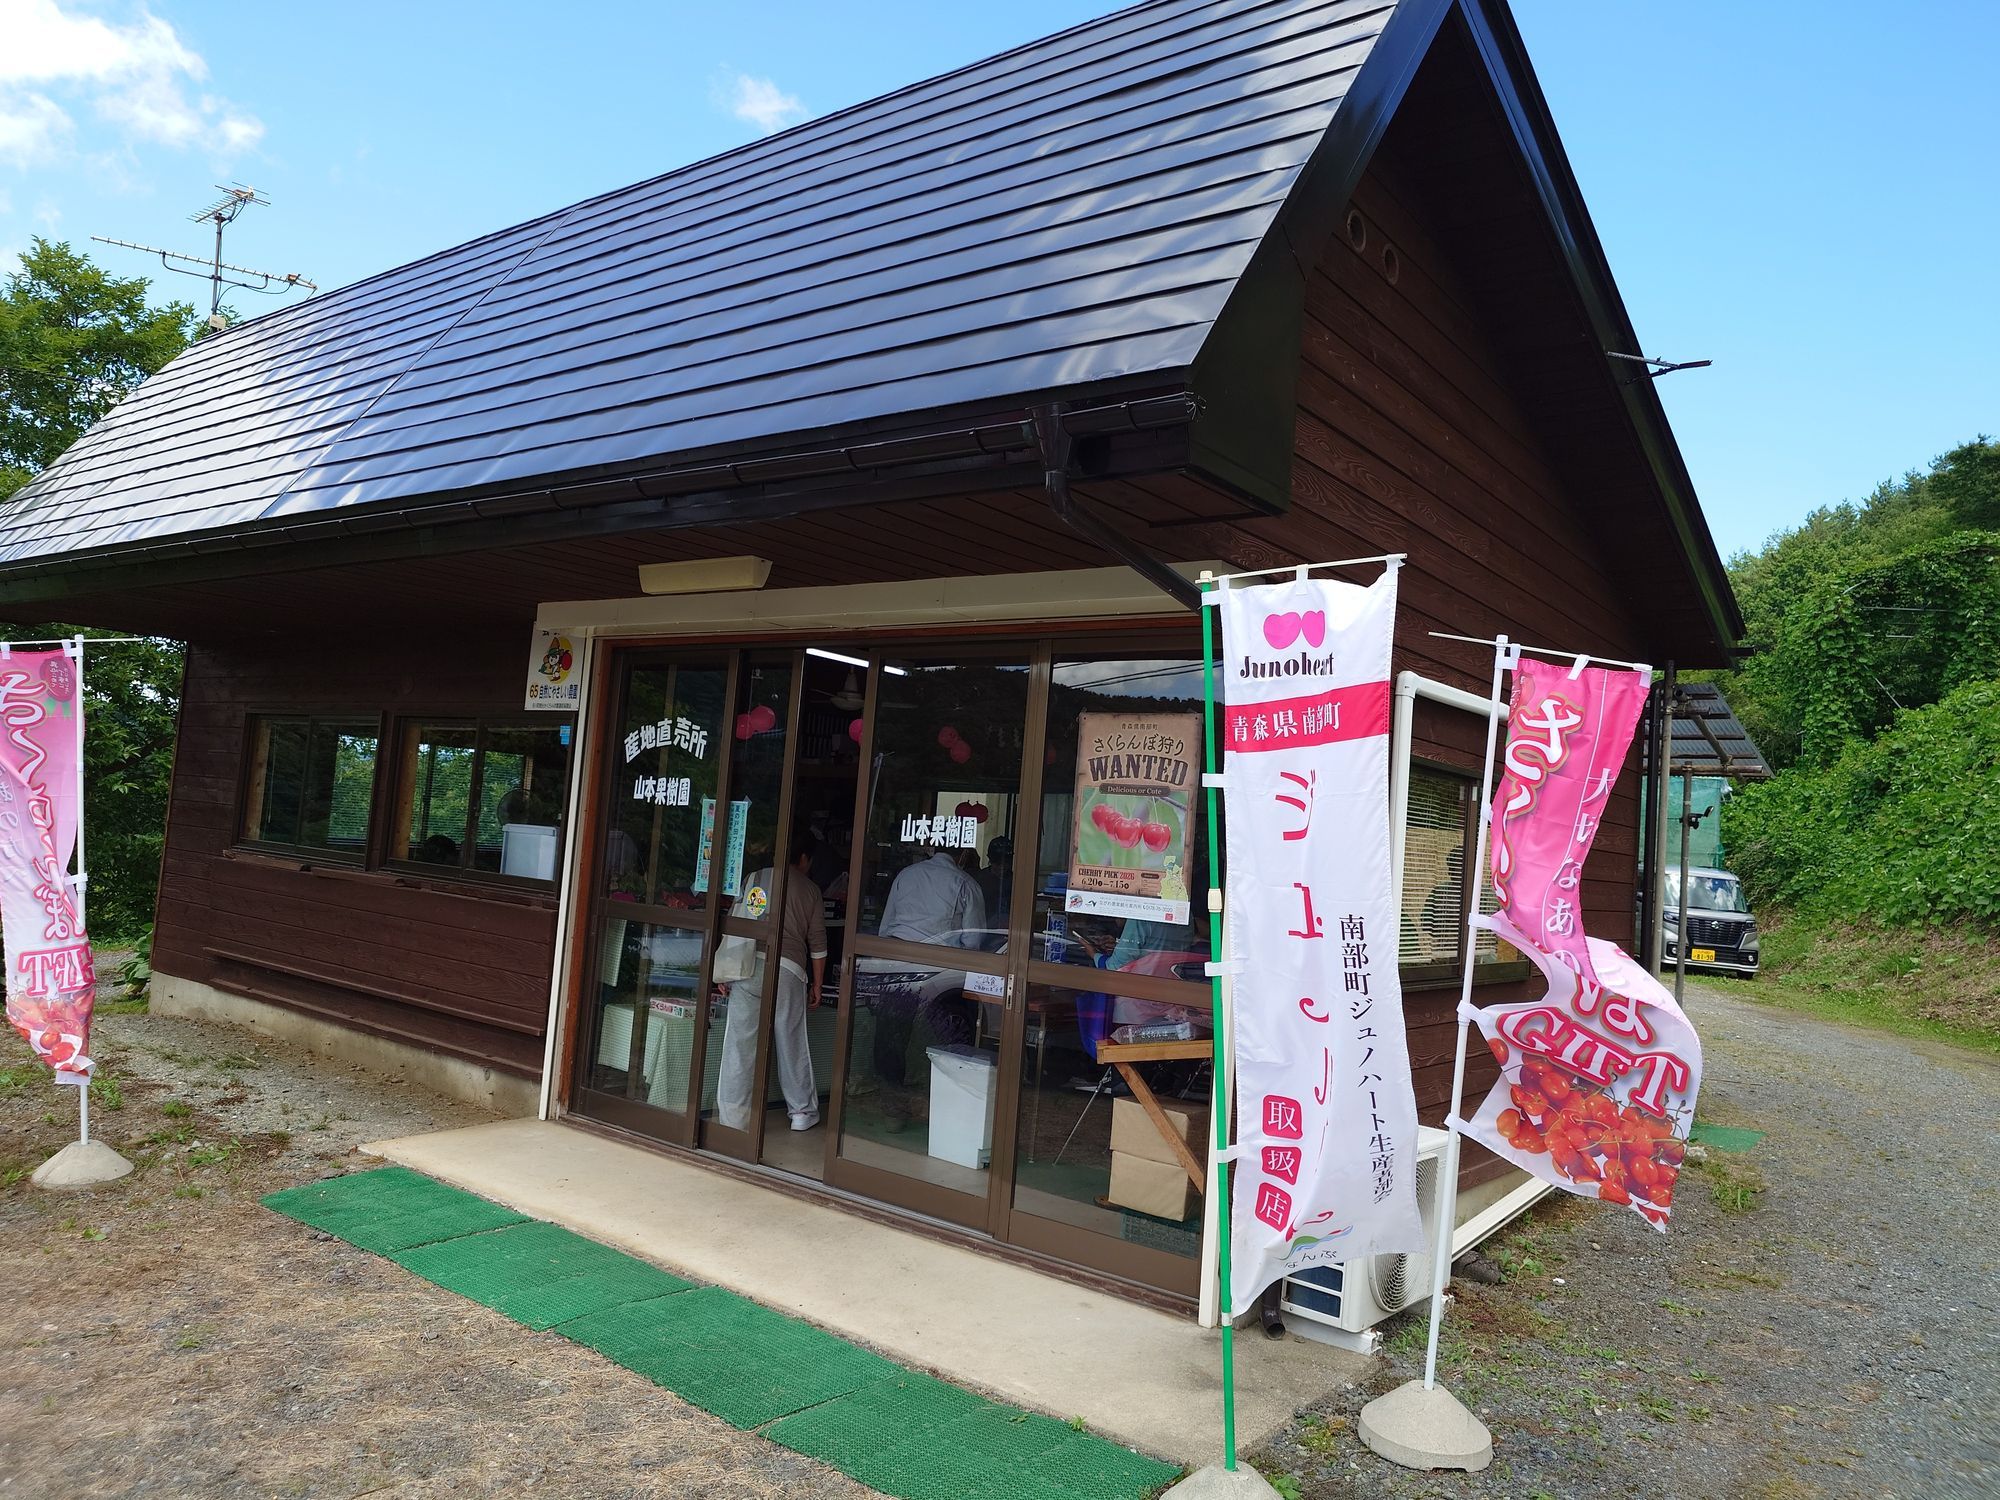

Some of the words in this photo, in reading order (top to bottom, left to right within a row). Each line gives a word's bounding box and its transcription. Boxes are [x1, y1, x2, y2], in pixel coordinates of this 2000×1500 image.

[529, 684, 539, 698] 65
[624, 716, 708, 764] 産地直売所
[1093, 733, 1185, 756] さくらんぼ狩り
[1087, 754, 1189, 787] WANTED
[633, 775, 691, 806] 山本果樹園
[1107, 785, 1137, 794] Delicious
[1146, 787, 1162, 795] Cute
[900, 813, 978, 849] 山本果樹園
[1078, 867, 1103, 878] CHERRY
[1103, 870, 1119, 879] PICK
[1498, 1008, 1688, 1116] GIFT
[1259, 1100, 1298, 1226] 取扱店
